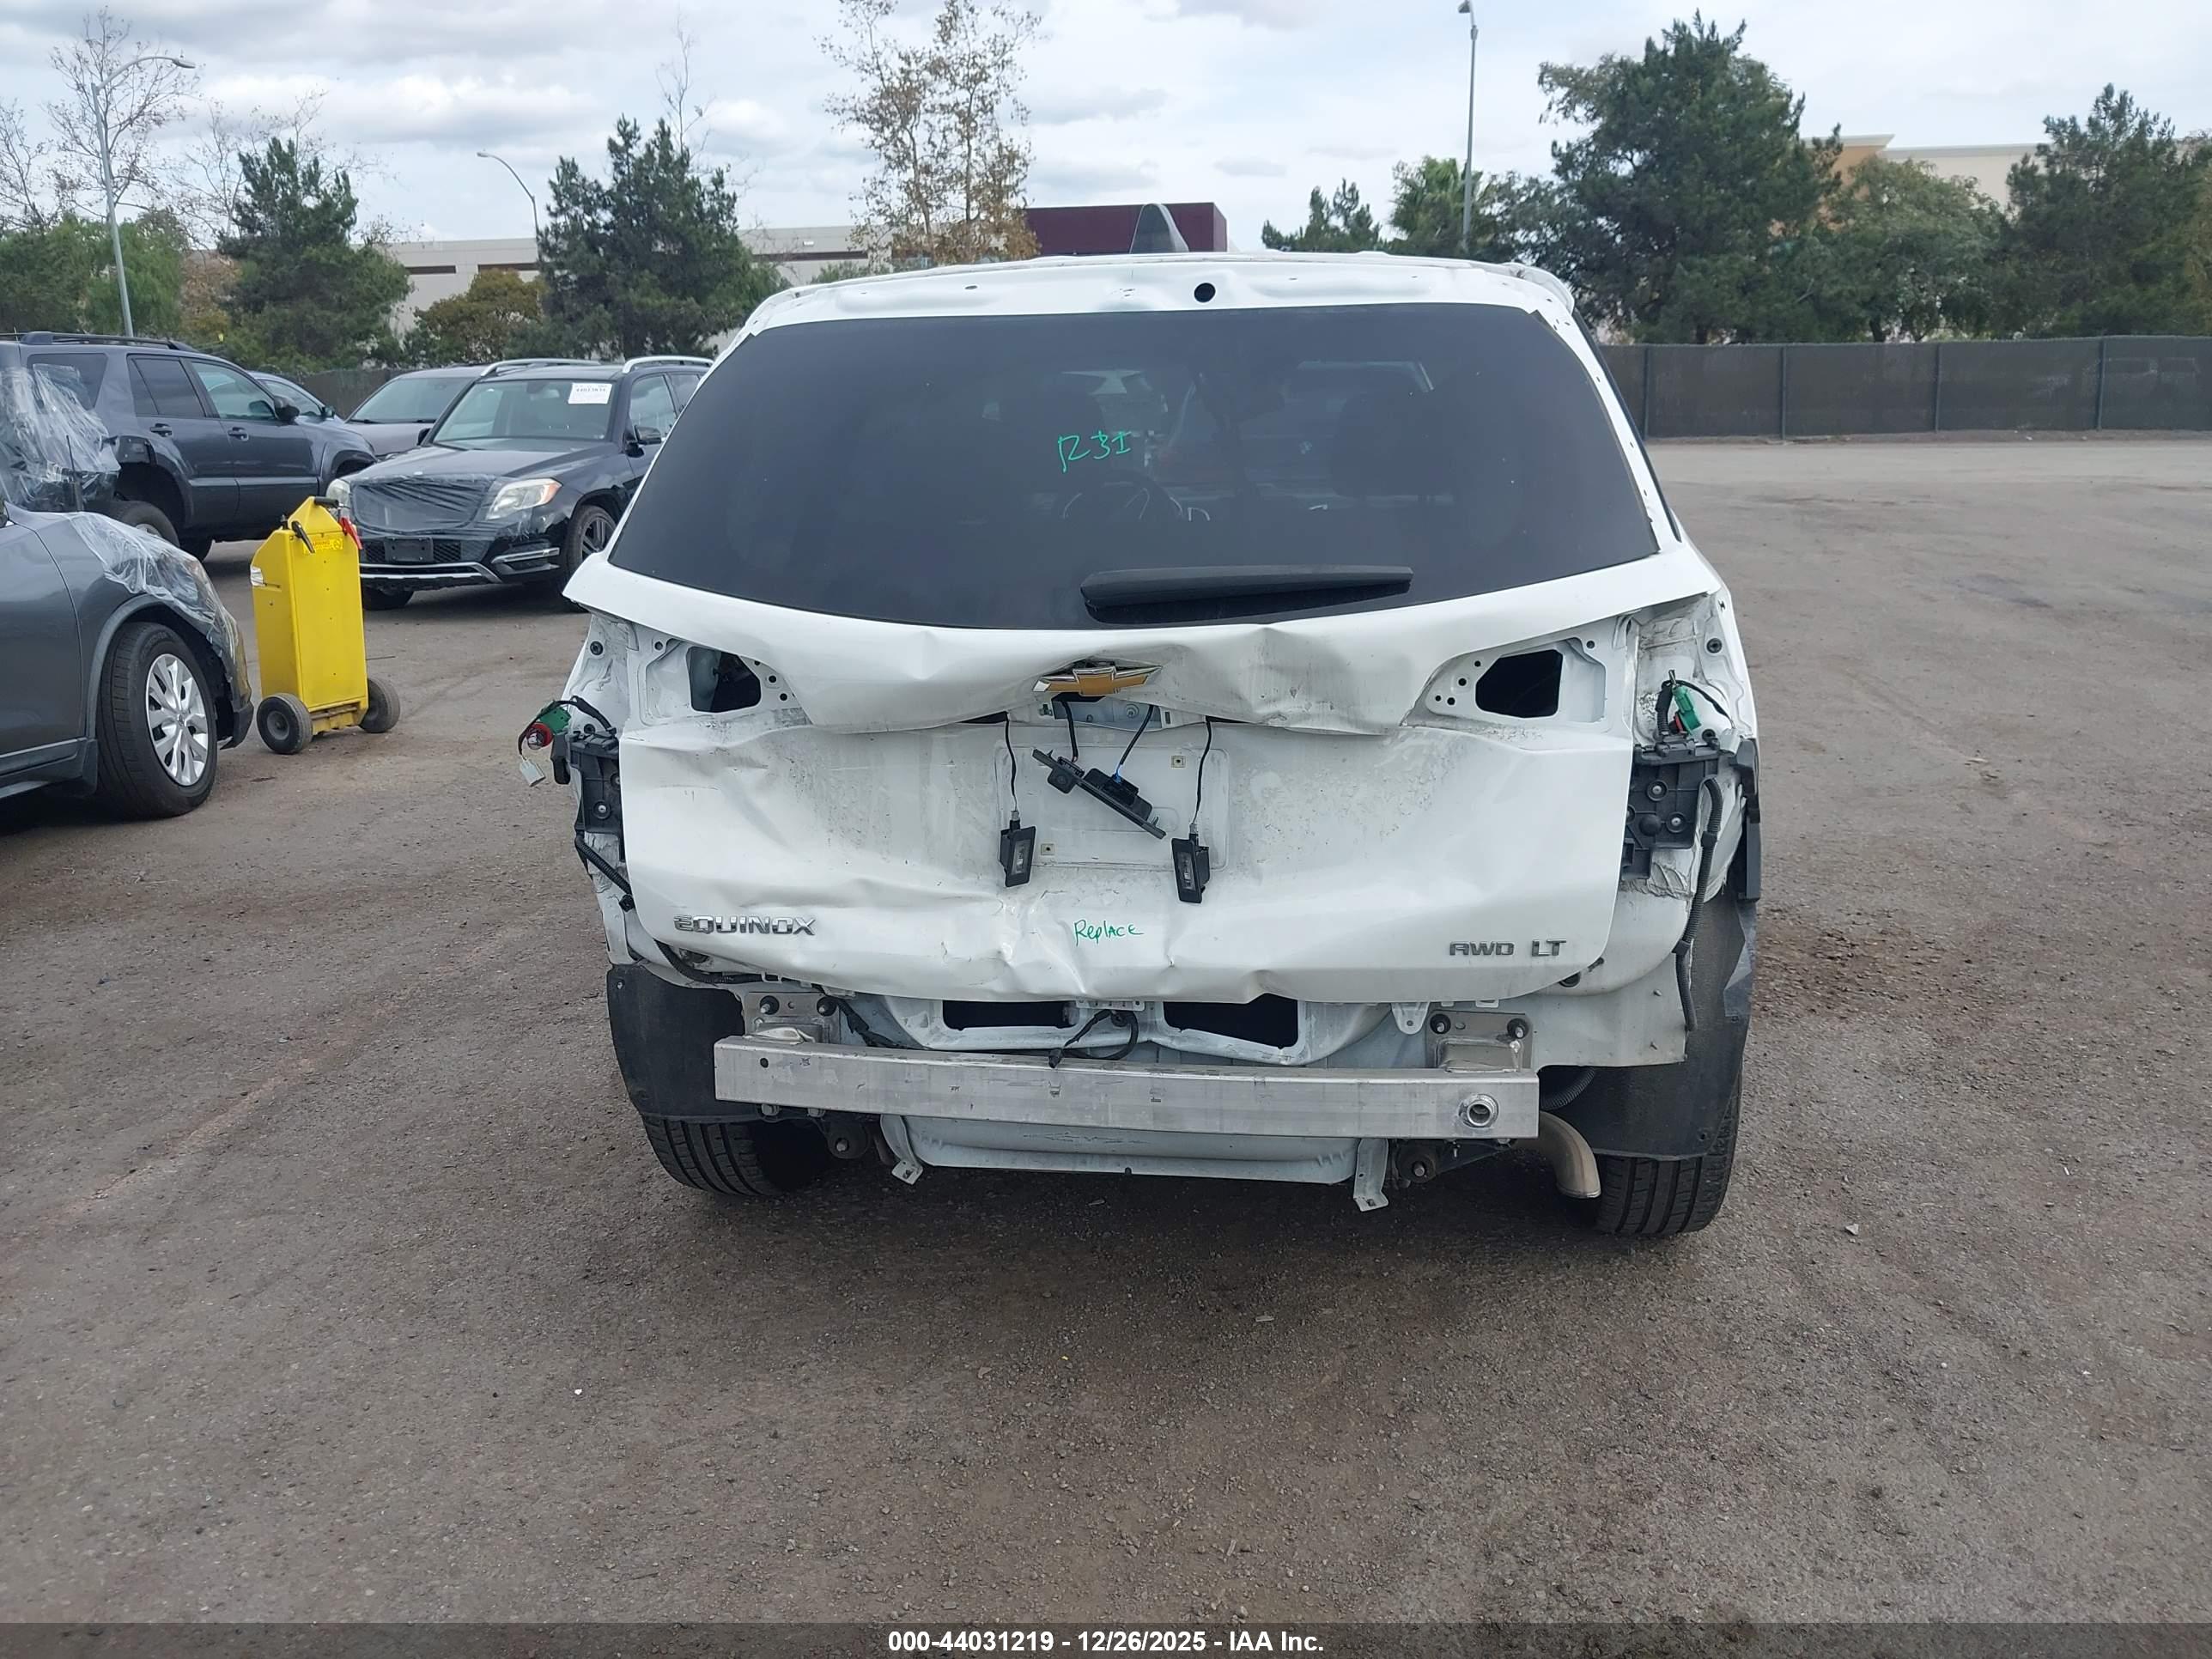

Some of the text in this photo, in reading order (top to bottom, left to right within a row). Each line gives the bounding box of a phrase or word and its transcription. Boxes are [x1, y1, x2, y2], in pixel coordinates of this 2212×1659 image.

[673, 915, 816, 936] EQUINOX
[1449, 939, 1567, 957] AWD LT
